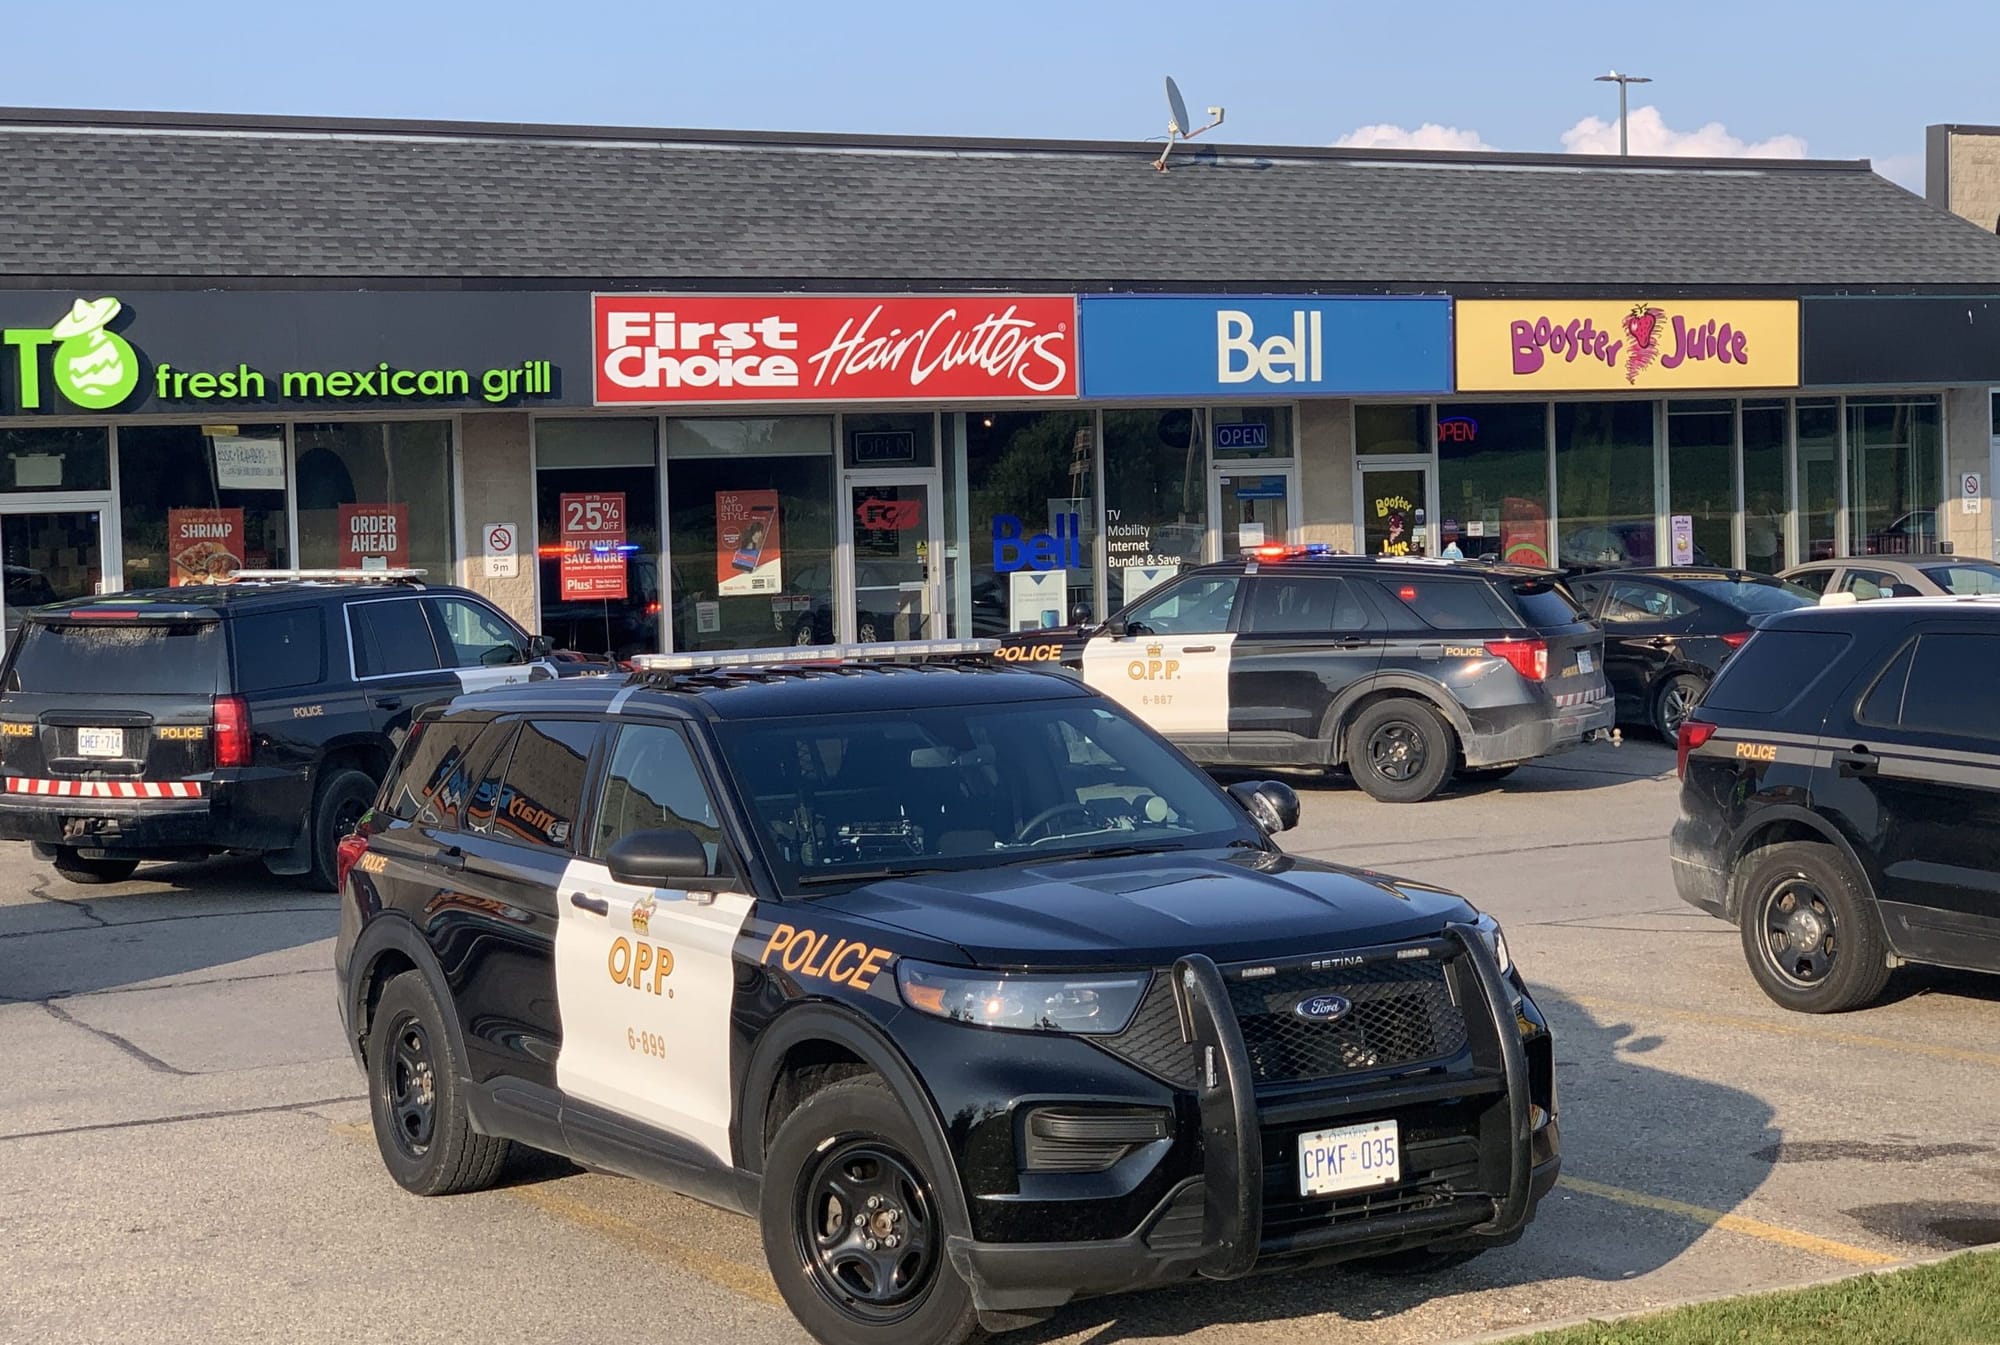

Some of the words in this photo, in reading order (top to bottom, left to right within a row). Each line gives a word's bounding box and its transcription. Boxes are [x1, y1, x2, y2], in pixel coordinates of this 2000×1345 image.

[607, 312, 798, 350] First
[1217, 310, 1322, 383] Bell
[1511, 316, 1623, 375] Booster
[1661, 315, 1748, 369] Juice
[603, 346, 799, 388] Choice
[155, 364, 265, 398] fresh
[283, 362, 469, 397] mexican
[482, 360, 551, 403] grill
[1219, 427, 1265, 446] OPEN
[720, 495, 738, 504] TAP
[1375, 495, 1412, 518] Booster
[720, 512, 749, 521] STYLE
[721, 504, 744, 513] INTO
[1107, 509, 1121, 521] TV
[180, 524, 233, 539] SHRIMP
[350, 516, 397, 534] ORDER
[602, 522, 619, 530] OFF
[1107, 524, 1150, 538] Mobility
[351, 534, 398, 553] AHEAD
[565, 540, 587, 550] BUY
[589, 540, 619, 550] MORE
[992, 513, 1080, 573] Bell
[1108, 541, 1150, 552] Internet
[564, 553, 591, 565] SAVE
[593, 552, 624, 563] MORE
[1108, 554, 1144, 568] Bundle
[1146, 555, 1155, 566] &
[1157, 553, 1182, 566] Save
[567, 579, 593, 591] Plus!
[994, 644, 1063, 661] POLICE
[1446, 647, 1483, 657] POLICE
[1127, 659, 1181, 681] O.P.P.
[293, 705, 324, 718] POLICE
[2, 723, 33, 736] POLICE
[160, 727, 204, 739] POLICE
[1736, 743, 1777, 760] POLICE
[360, 851, 388, 873] POLICE
[760, 923, 893, 991] POLICE
[1311, 954, 1364, 970] SETINA
[607, 936, 675, 999] O.P.P.
[1311, 997, 1341, 1015] Ford
[627, 1027, 667, 1060] 6-899
